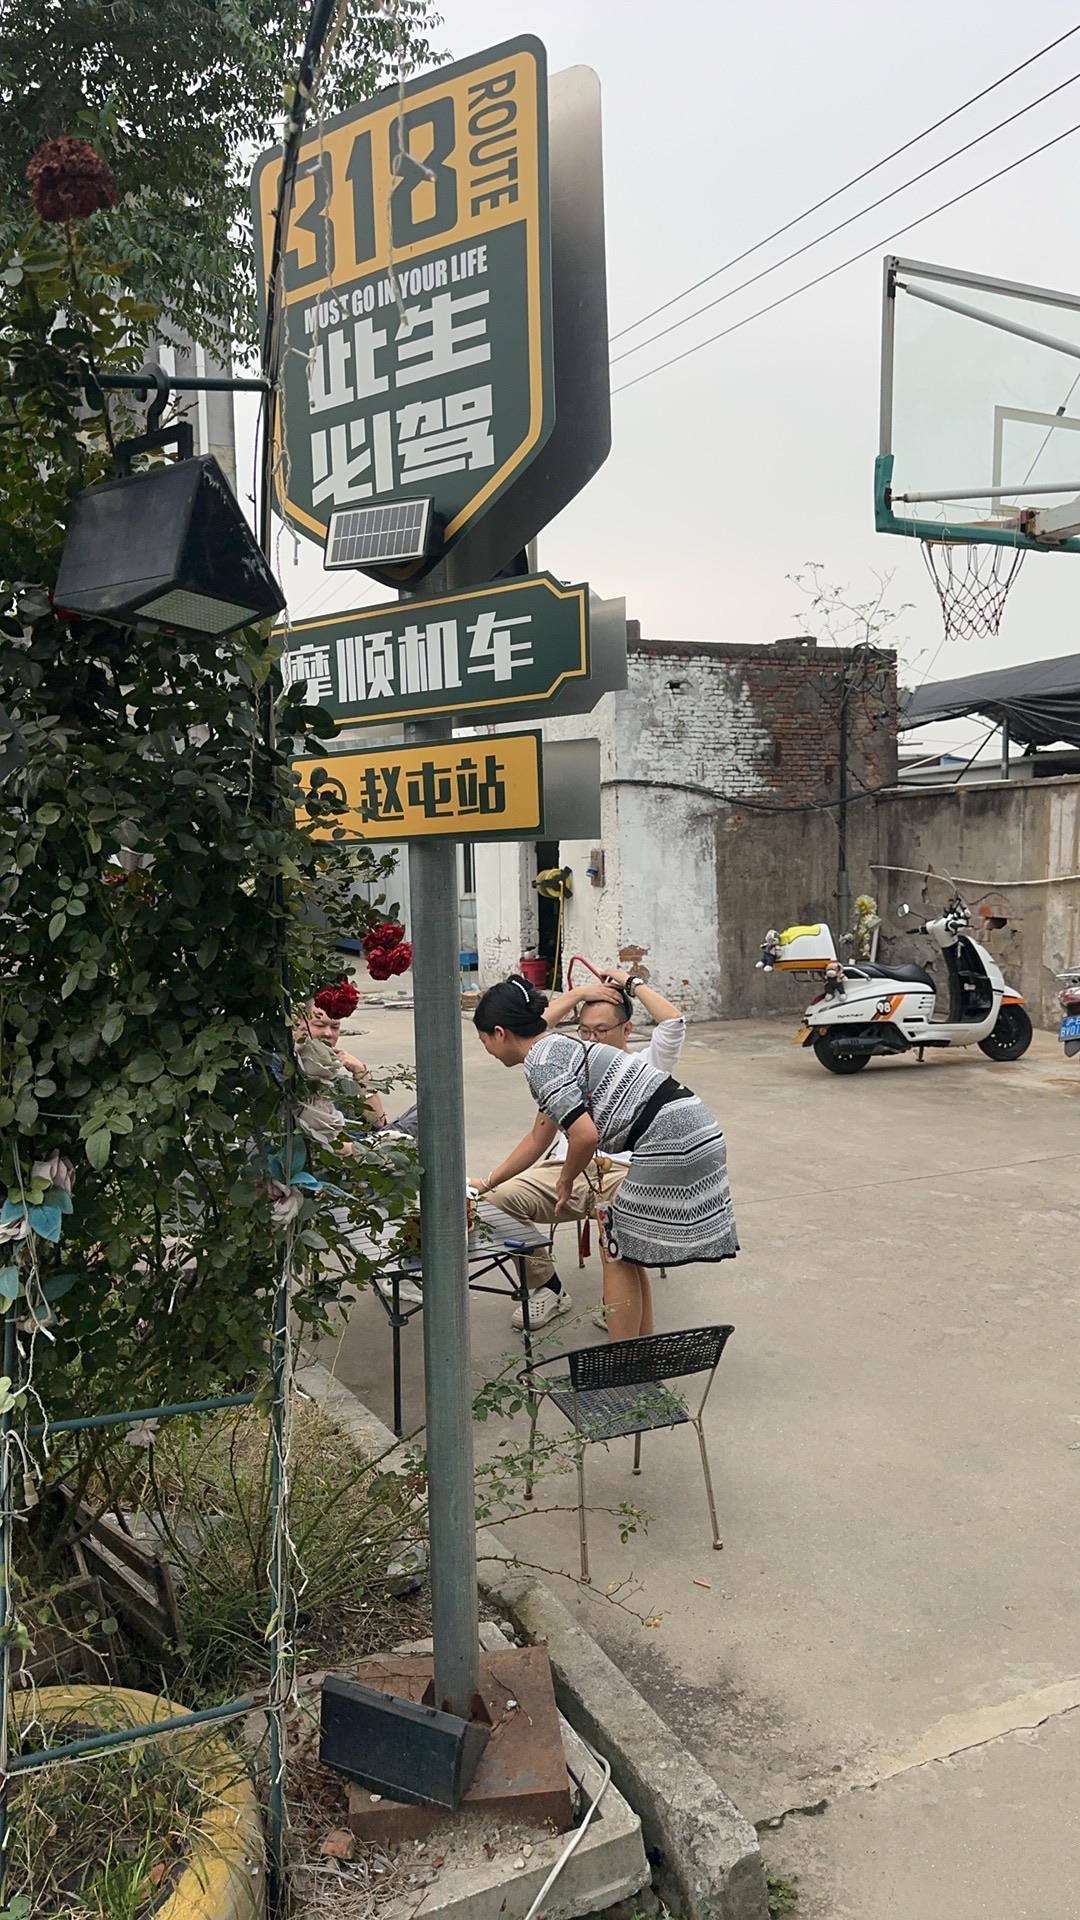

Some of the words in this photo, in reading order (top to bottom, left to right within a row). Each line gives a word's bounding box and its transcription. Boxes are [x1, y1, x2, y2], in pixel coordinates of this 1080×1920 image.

[278, 96, 458, 293] 318
[468, 69, 519, 218] ROUTE
[304, 293, 349, 335] MUST
[351, 285, 374, 317] GO
[378, 277, 397, 307] IN
[398, 259, 448, 300] YOUR
[451, 244, 488, 283] LIFE
[308, 290, 492, 415] 此生
[311, 384, 495, 507] 必驾
[280, 611, 534, 707] 摩顺机车
[876, 1002, 891, 1013] 98
